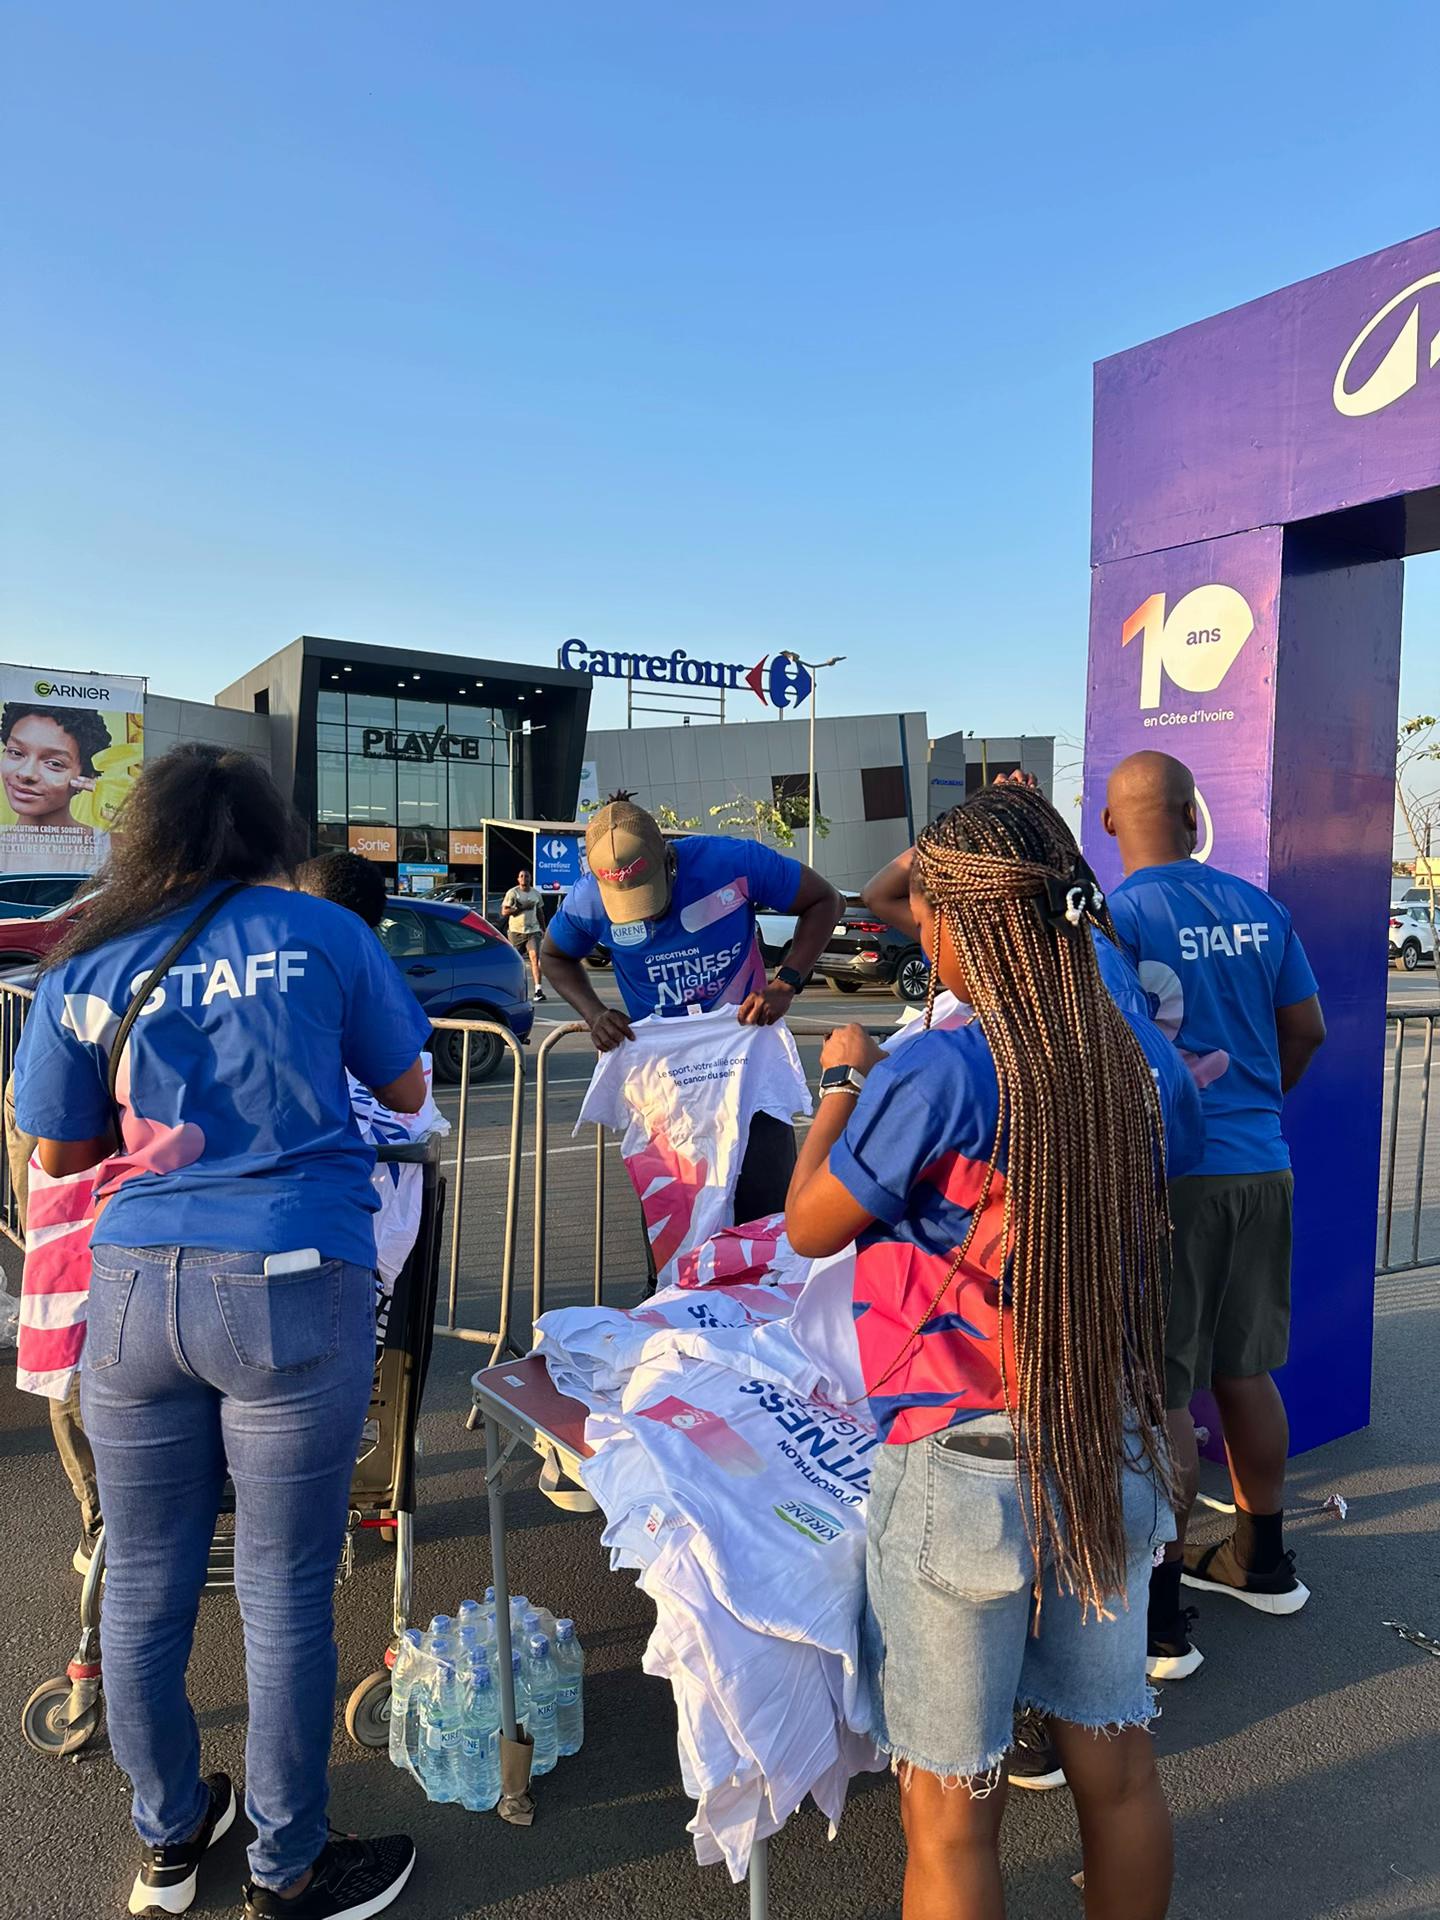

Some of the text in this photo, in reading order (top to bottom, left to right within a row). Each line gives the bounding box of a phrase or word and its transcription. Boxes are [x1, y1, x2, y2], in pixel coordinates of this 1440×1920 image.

[1186, 627, 1221, 646] ans
[561, 638, 745, 689] Carrefour
[36, 681, 110, 701] GARNIER
[1143, 708, 1234, 728] en Côte d'Ivoire
[357, 838, 391, 852] Sortie
[1178, 922, 1269, 961] STAFF
[647, 942, 742, 983] FITNESS
[655, 947, 700, 962] DECATHLON
[130, 950, 308, 1016] STAFF
[654, 963, 723, 1016] NIGHT
[668, 1064, 694, 1077] sport,
[730, 1057, 748, 1066] cont
[674, 1079, 683, 1087] le
[707, 1071, 718, 1080] du
[719, 1069, 736, 1079] sein
[777, 1439, 845, 1500] DECATHLON
